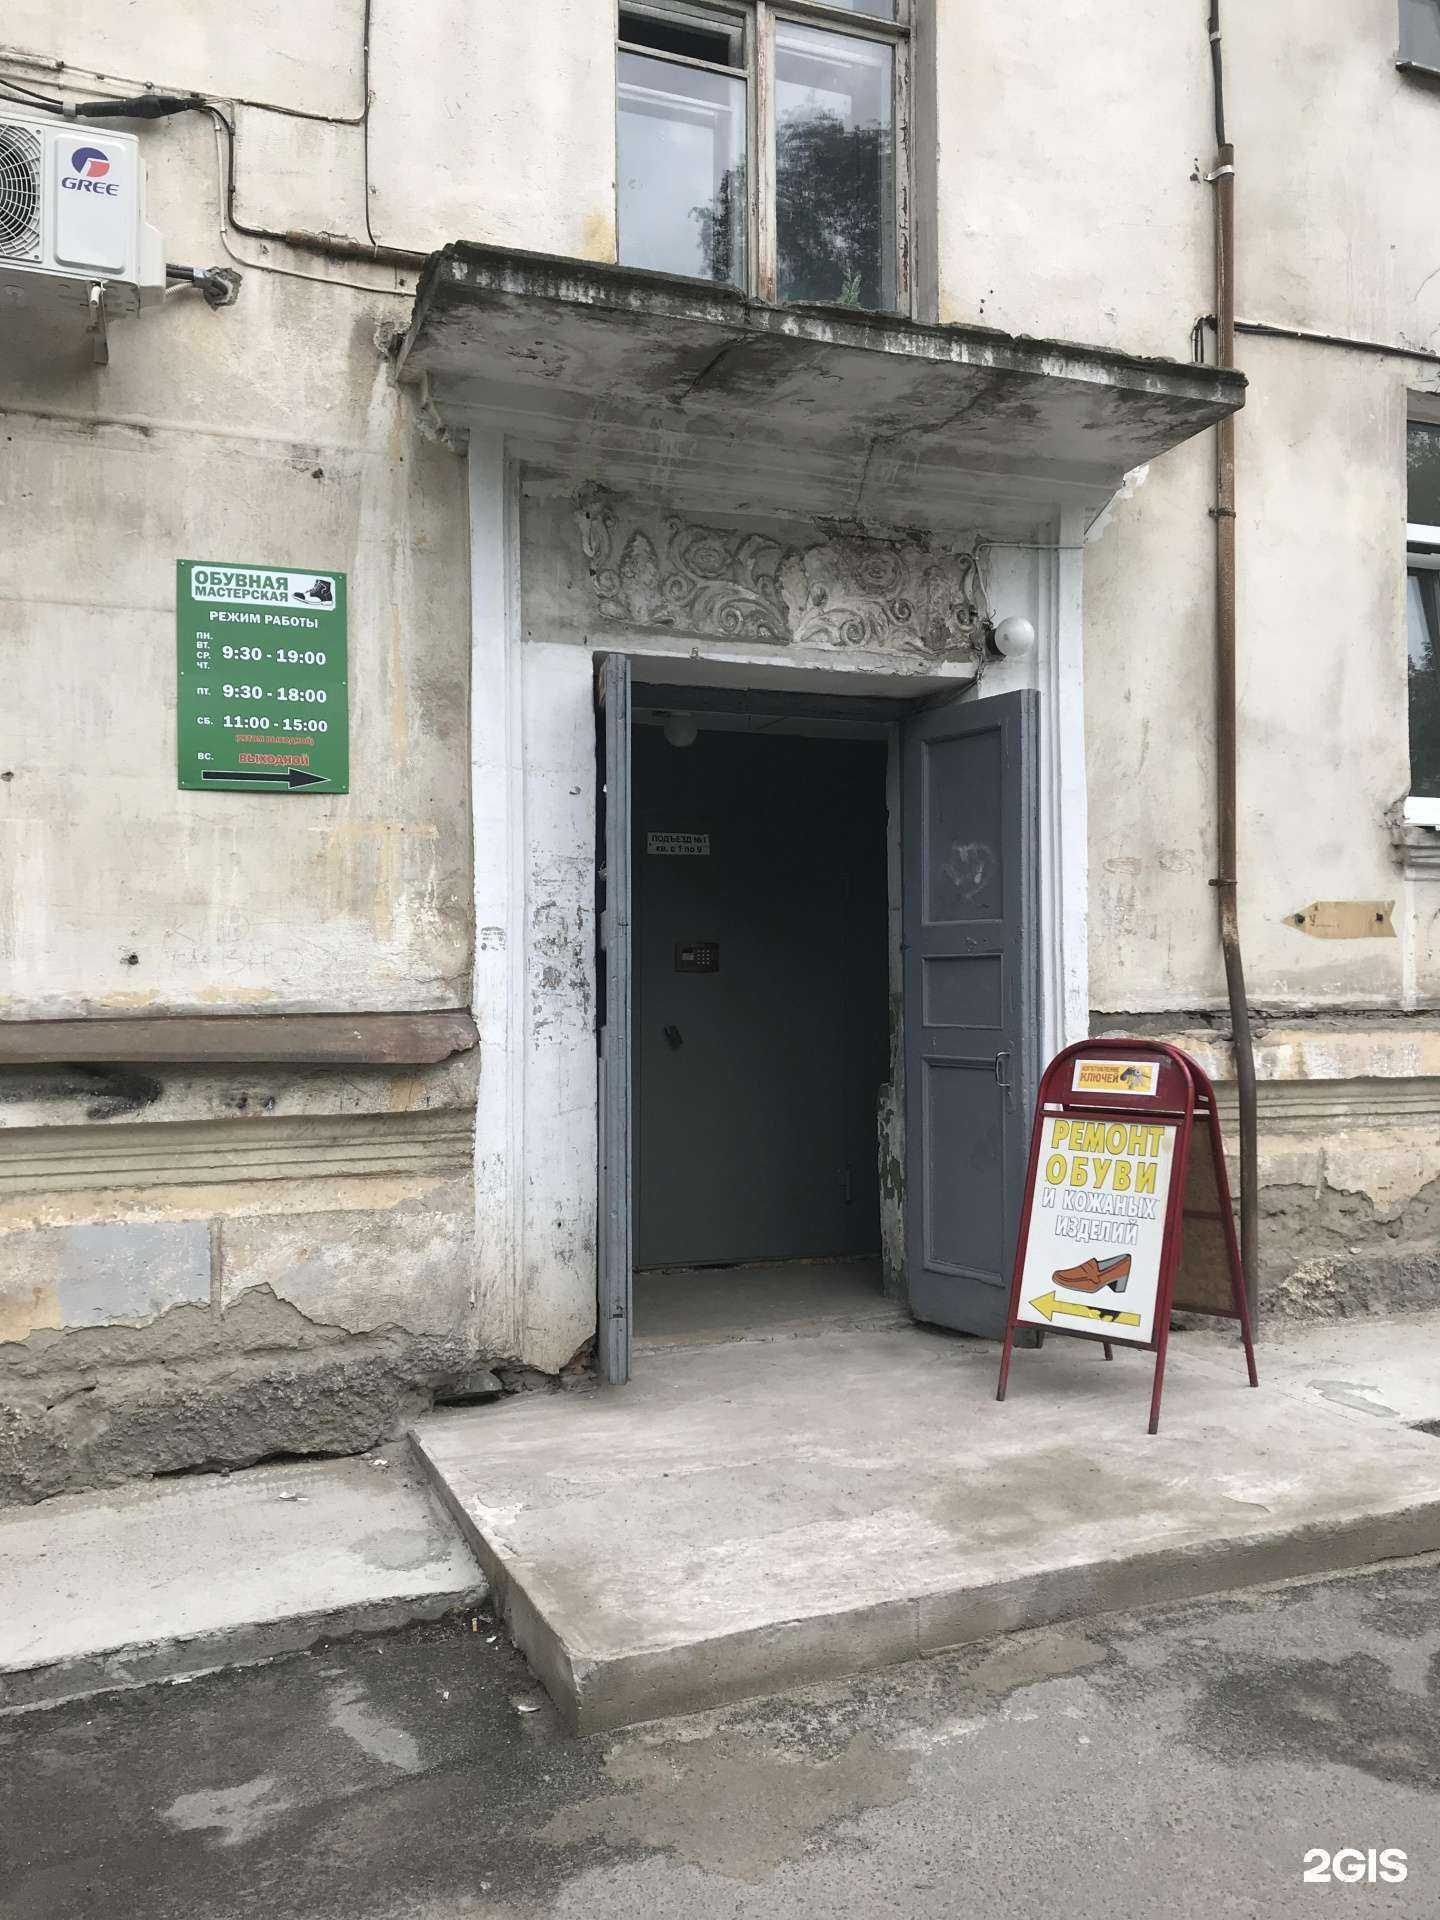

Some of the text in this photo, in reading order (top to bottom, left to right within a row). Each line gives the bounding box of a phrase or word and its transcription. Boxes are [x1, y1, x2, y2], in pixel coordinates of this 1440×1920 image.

[61, 177, 120, 197] GREE
[194, 570, 289, 591] ОБУВНАЯ
[194, 585, 289, 603] МАСТЕРСКАЯ
[209, 611, 319, 629] РЕЖИМ РАБОТЫ
[196, 631, 213, 640] ПН.
[196, 641, 210, 649] ВТ.
[196, 651, 211, 660] СР.
[222, 645, 262, 661] 9:30
[276, 649, 327, 665] 19:00
[196, 661, 211, 670] ЧТ.
[196, 687, 211, 696] ПТ.
[222, 684, 263, 699] 9:30
[277, 687, 327, 703] 18:00
[196, 716, 214, 725] СБ.
[223, 715, 270, 729] 11:00
[282, 718, 328, 732] 15:00
[197, 752, 310, 767] ВС. ВЫХОДНОЙ
[1080, 1072, 1119, 1084] КЛЮЧЕЙ
[1051, 1119, 1166, 1158] РЕМОНТ
[1045, 1153, 1158, 1194] ОБУВИ
[1041, 1187, 1161, 1220] И КОЖАНЫХ
[1055, 1214, 1139, 1246] ИЗДЕЛИЙ
